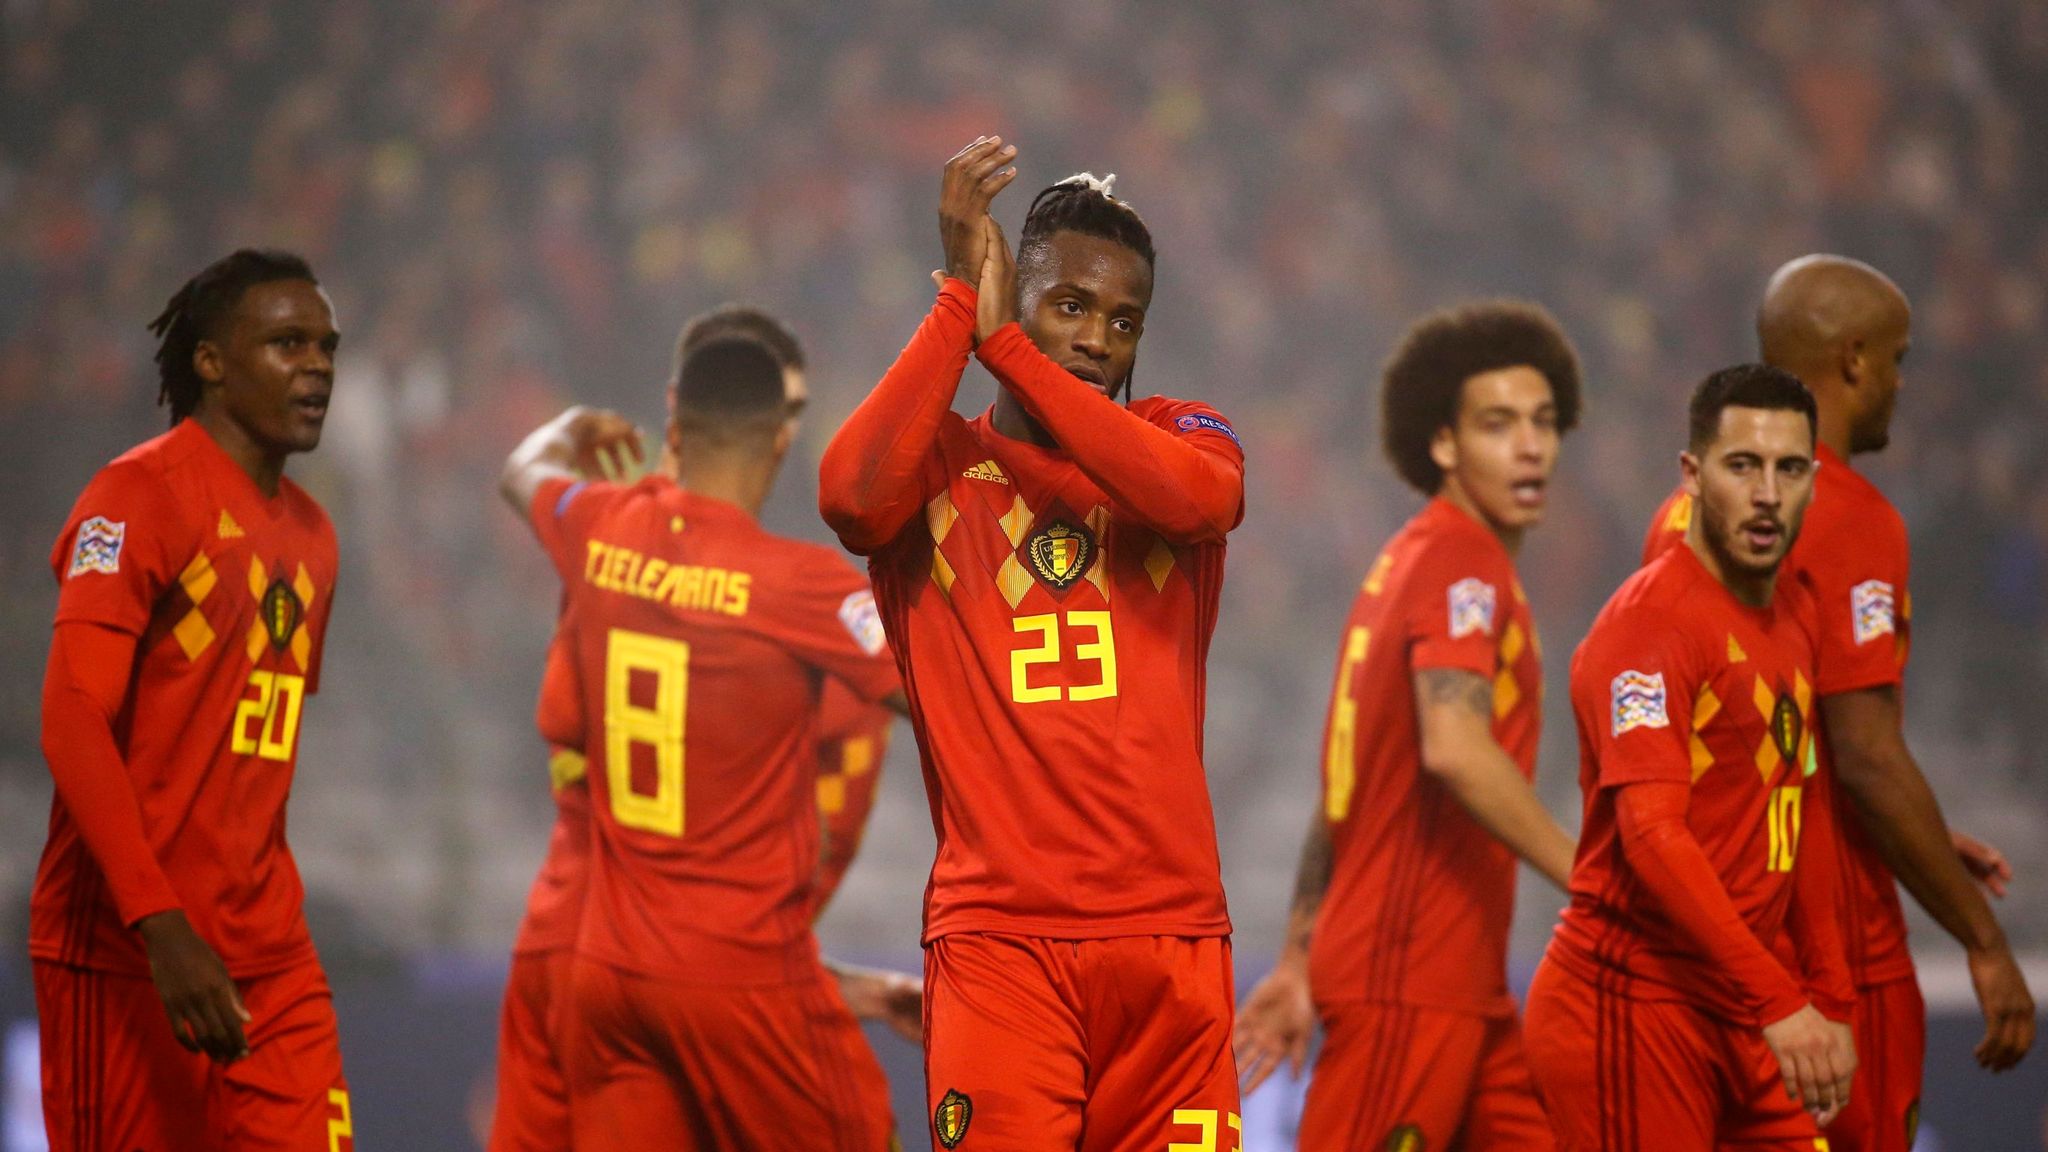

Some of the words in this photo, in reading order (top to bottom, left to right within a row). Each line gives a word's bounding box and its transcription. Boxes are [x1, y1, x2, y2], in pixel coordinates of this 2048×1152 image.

[963, 471, 1009, 485] adidas
[1011, 611, 1117, 703] 23
[231, 670, 305, 762] 20
[605, 629, 689, 837] 8
[1767, 786, 1802, 872] 10
